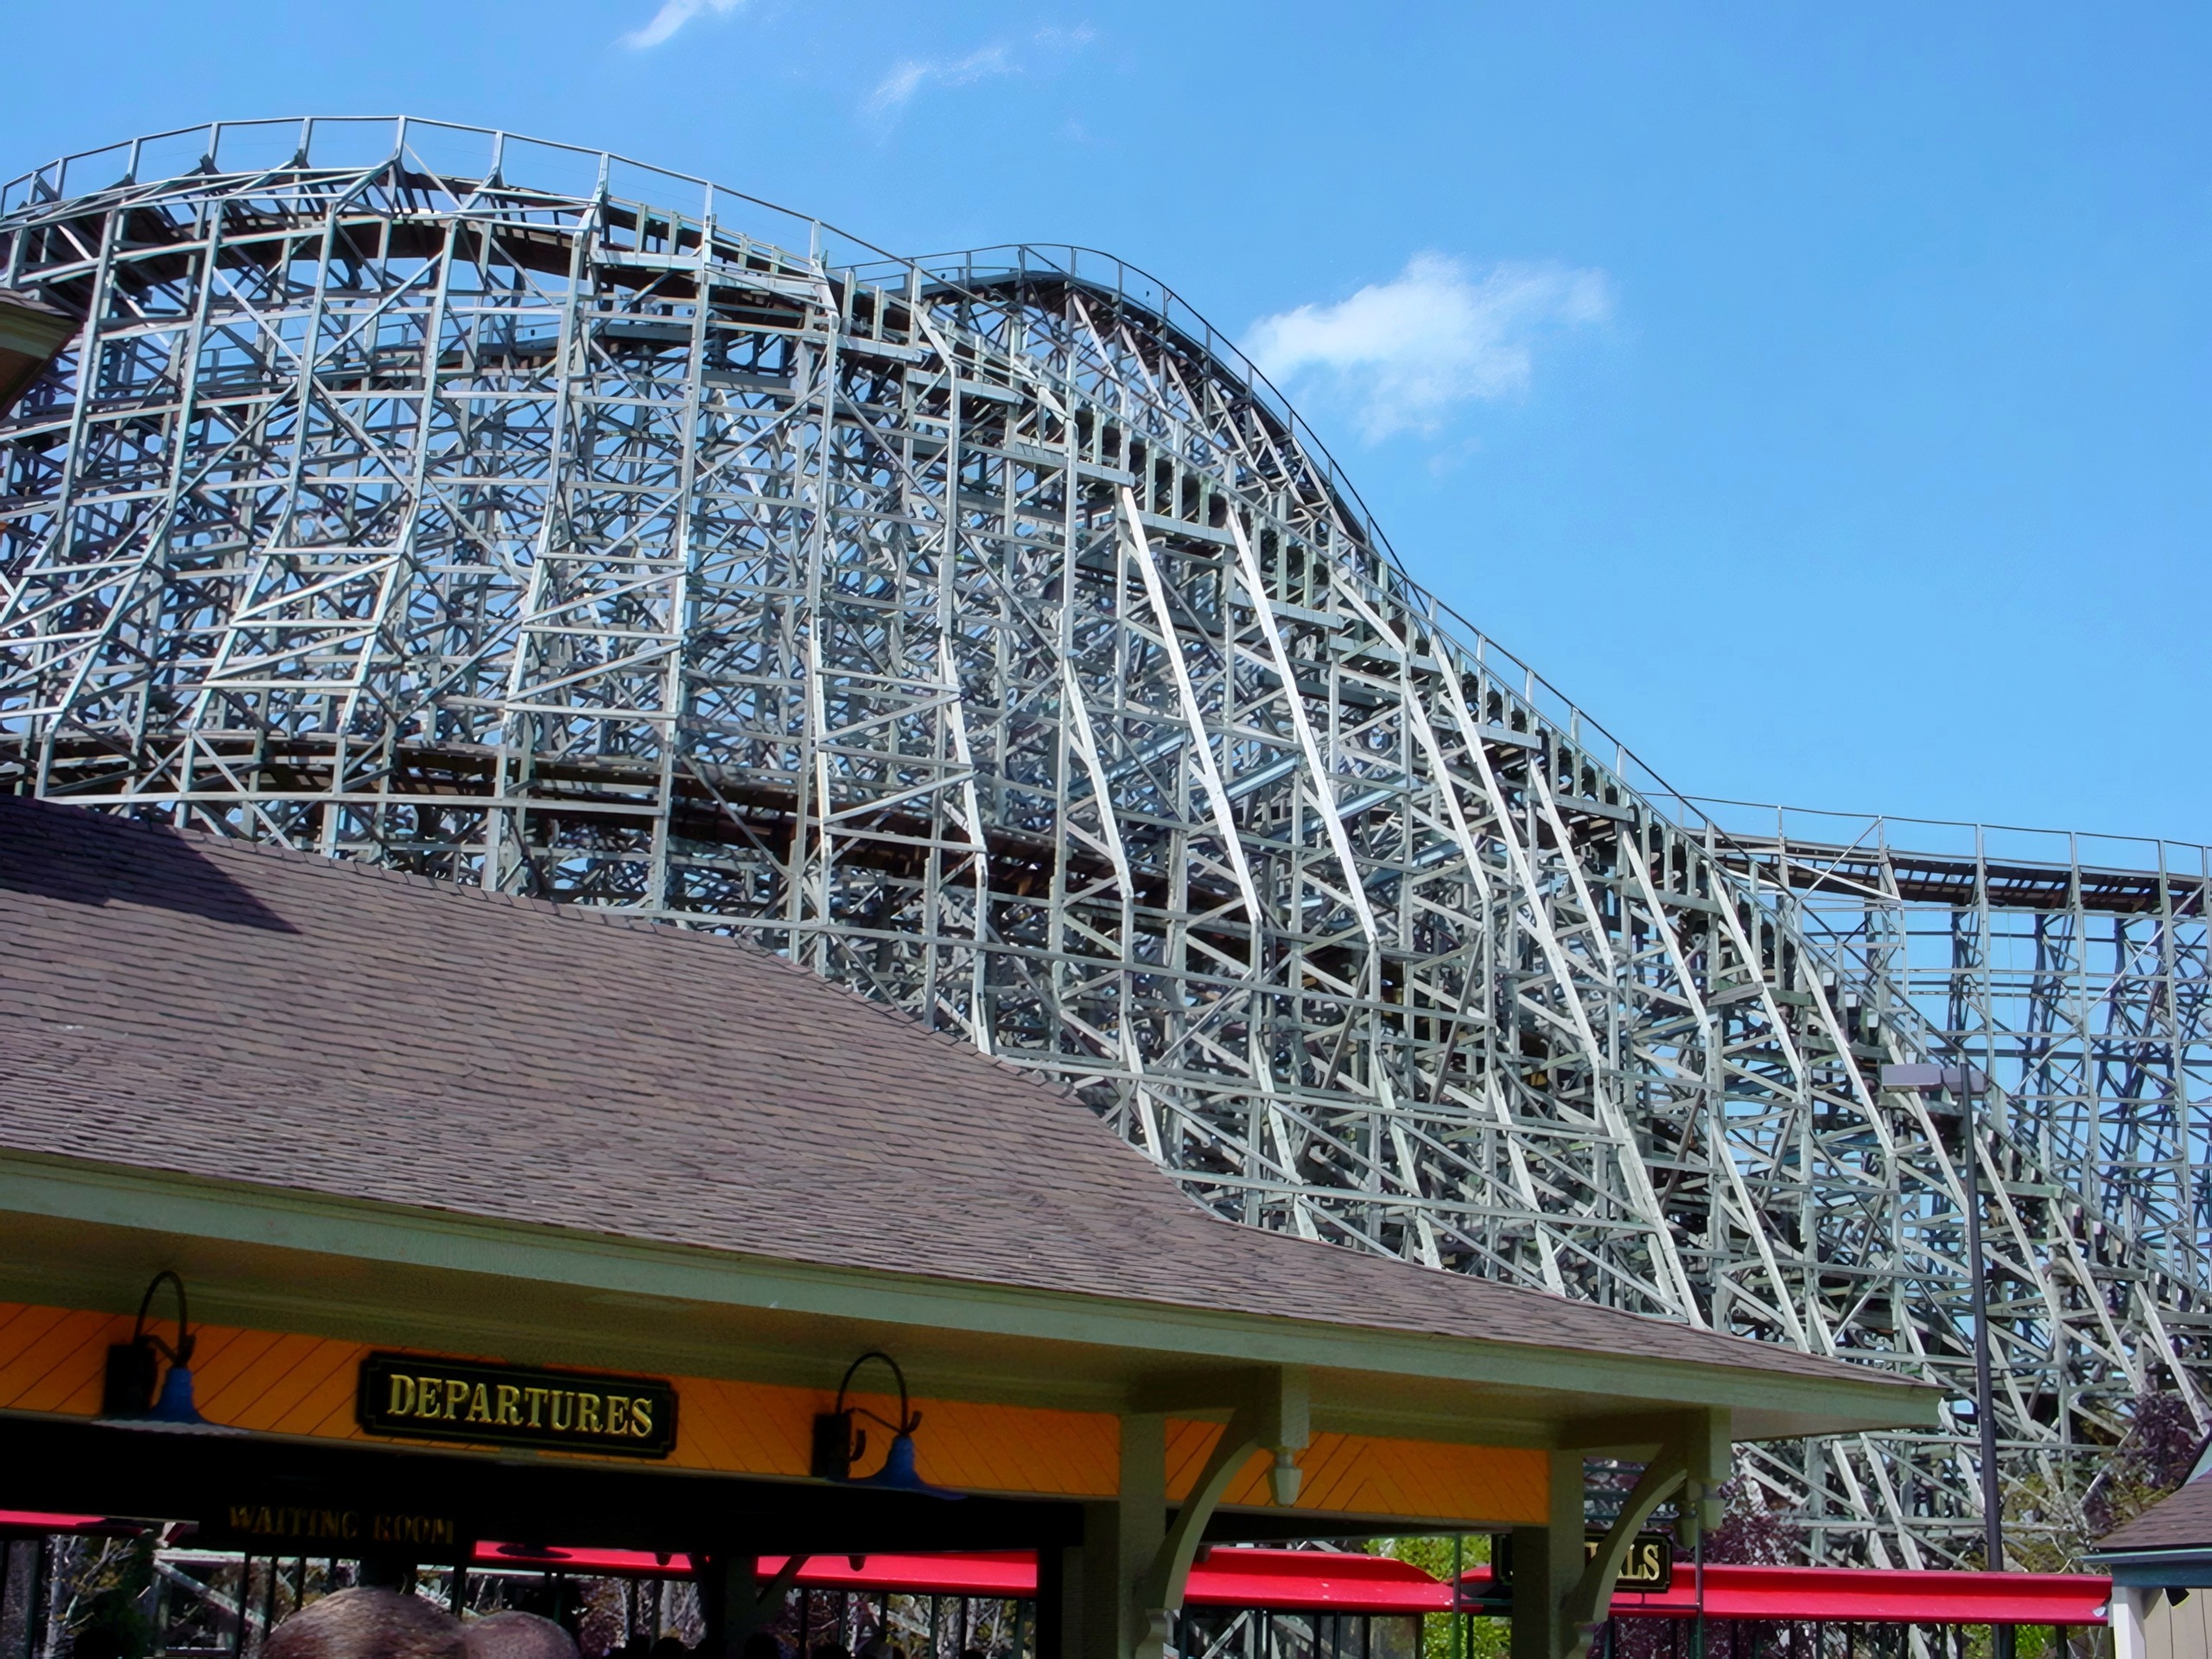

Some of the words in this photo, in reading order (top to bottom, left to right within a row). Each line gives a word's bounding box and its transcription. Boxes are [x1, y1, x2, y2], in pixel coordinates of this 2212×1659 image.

[386, 1374, 653, 1437] DEPARTURES
[229, 1506, 359, 1540] WAITING
[373, 1513, 454, 1545] ROOM
